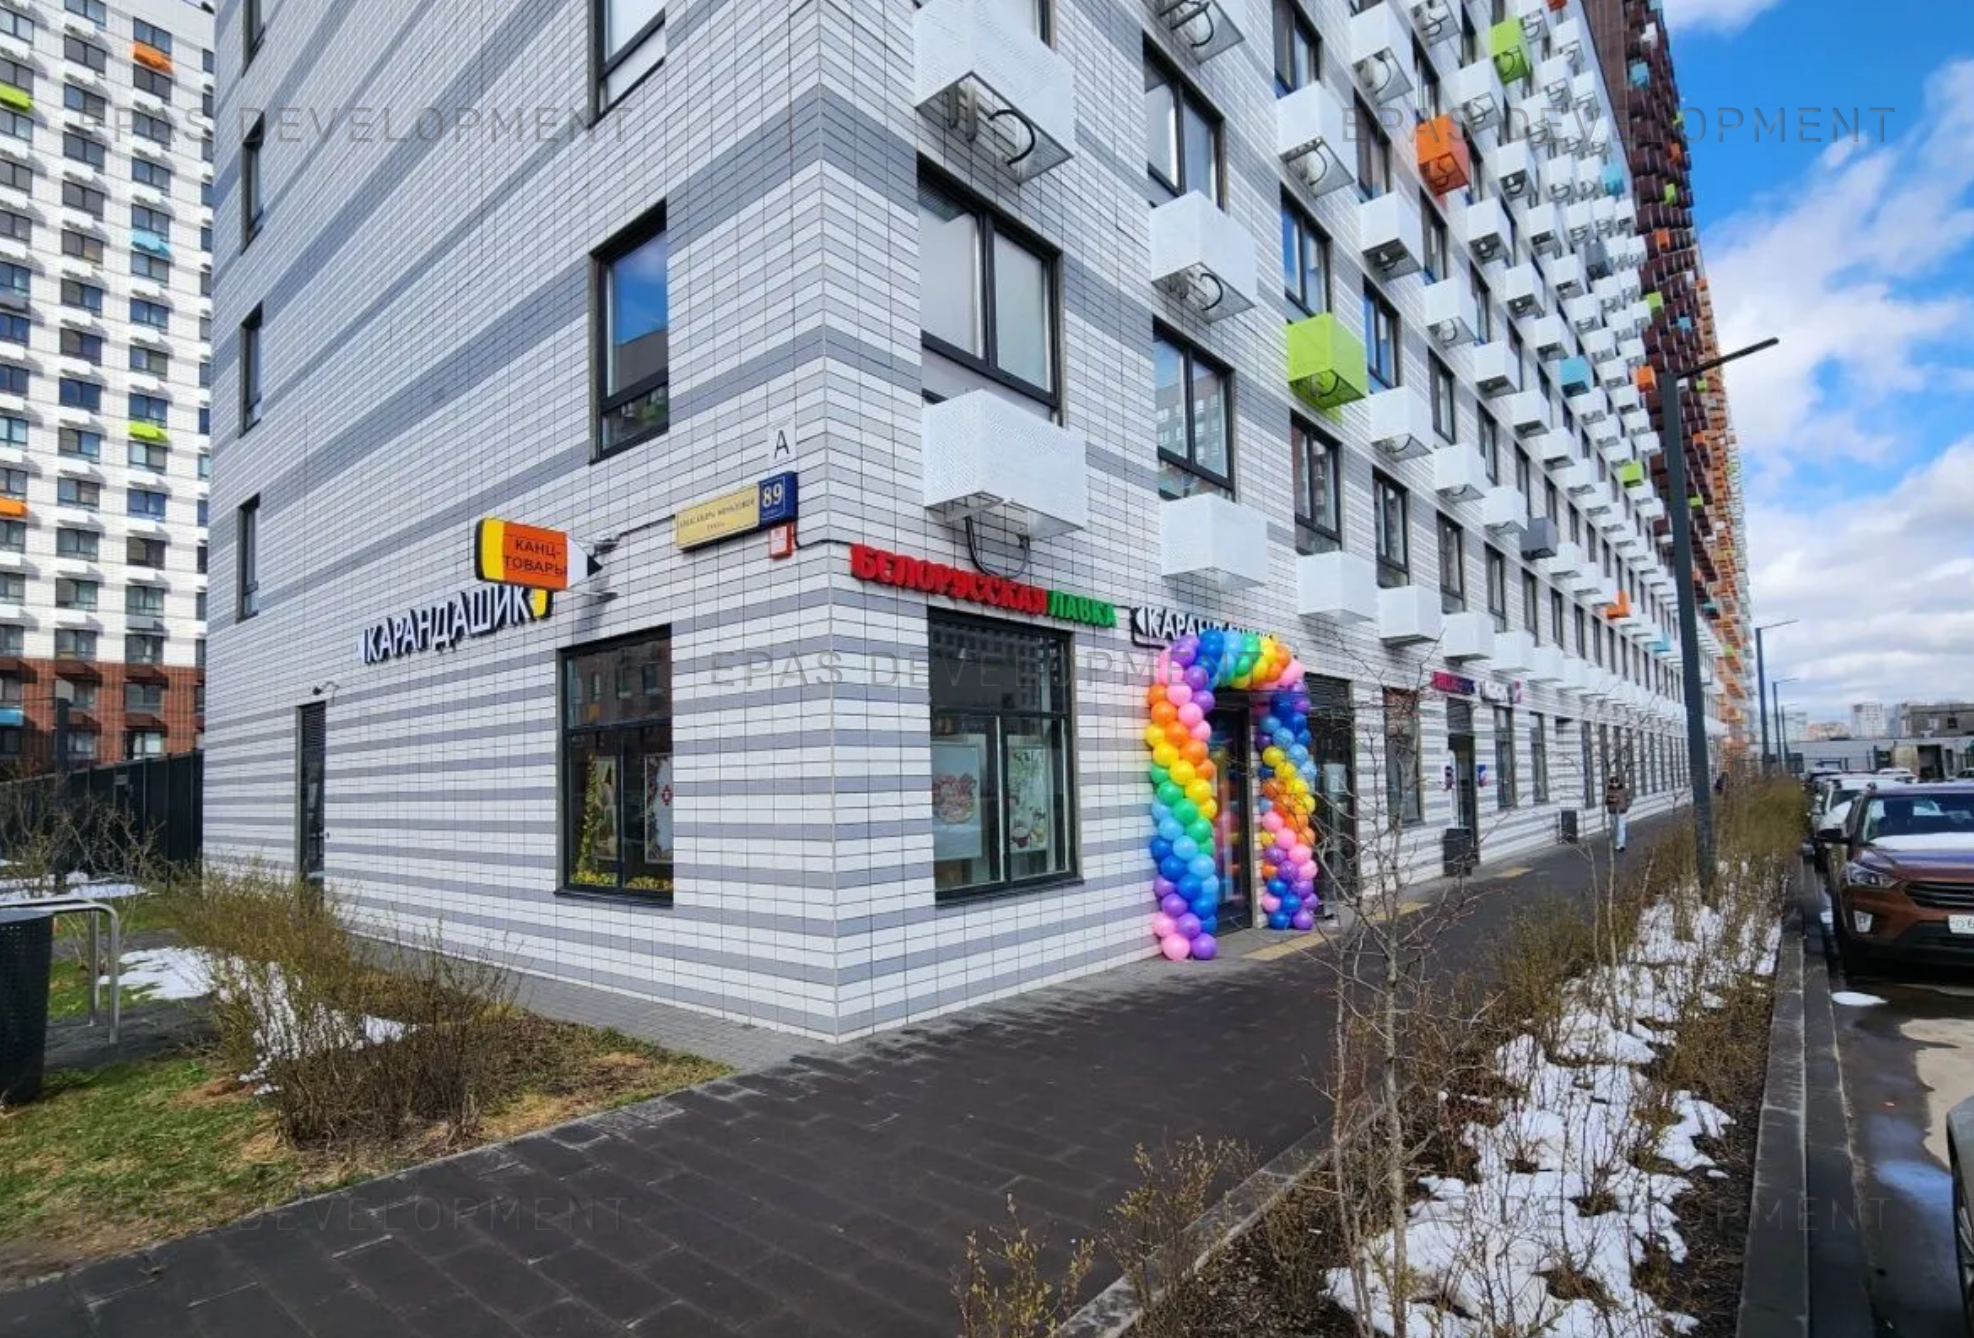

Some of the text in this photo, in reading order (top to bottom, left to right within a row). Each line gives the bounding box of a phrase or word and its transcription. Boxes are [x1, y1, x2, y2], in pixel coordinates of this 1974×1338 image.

[774, 430, 790, 459] А
[762, 483, 783, 508] 89
[515, 539, 562, 559] КАНЦ-
[504, 555, 568, 576] ТОВАРЫ
[850, 544, 1047, 616] БЕЛОРУССКАЯ
[1047, 590, 1117, 628] ЛАВКА
[365, 583, 533, 664] КАРАНДАШИК
